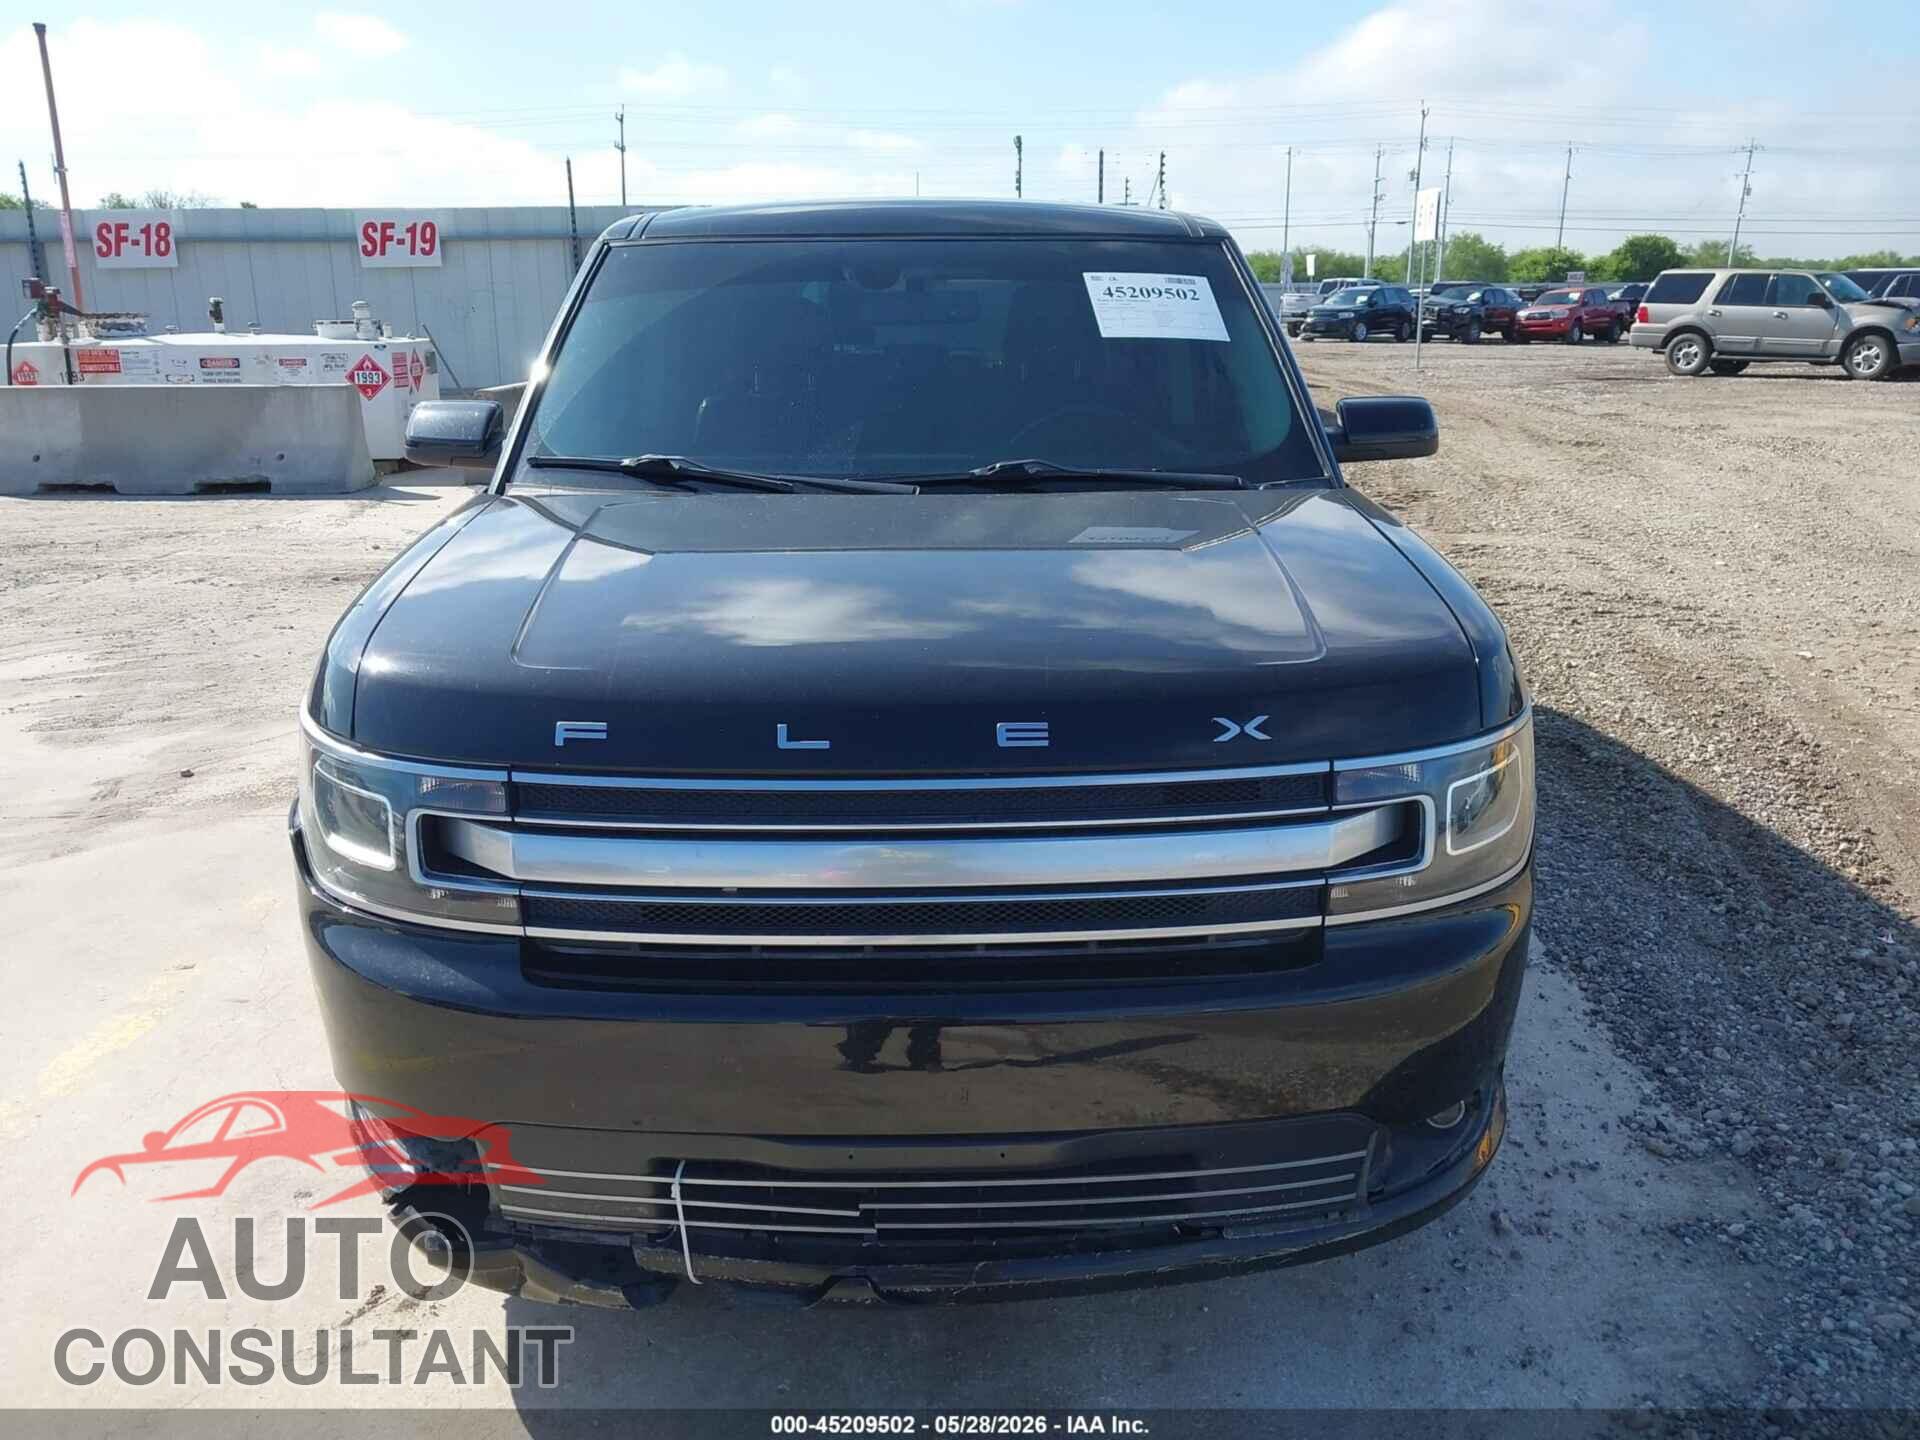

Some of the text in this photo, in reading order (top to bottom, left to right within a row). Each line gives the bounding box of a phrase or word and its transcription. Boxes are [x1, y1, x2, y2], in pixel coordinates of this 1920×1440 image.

[96, 222, 171, 257] SF-18
[361, 222, 436, 257] SF-19
[1102, 286, 1200, 301] 45209502
[60, 371, 85, 382] 193
[356, 372, 380, 383] 1993
